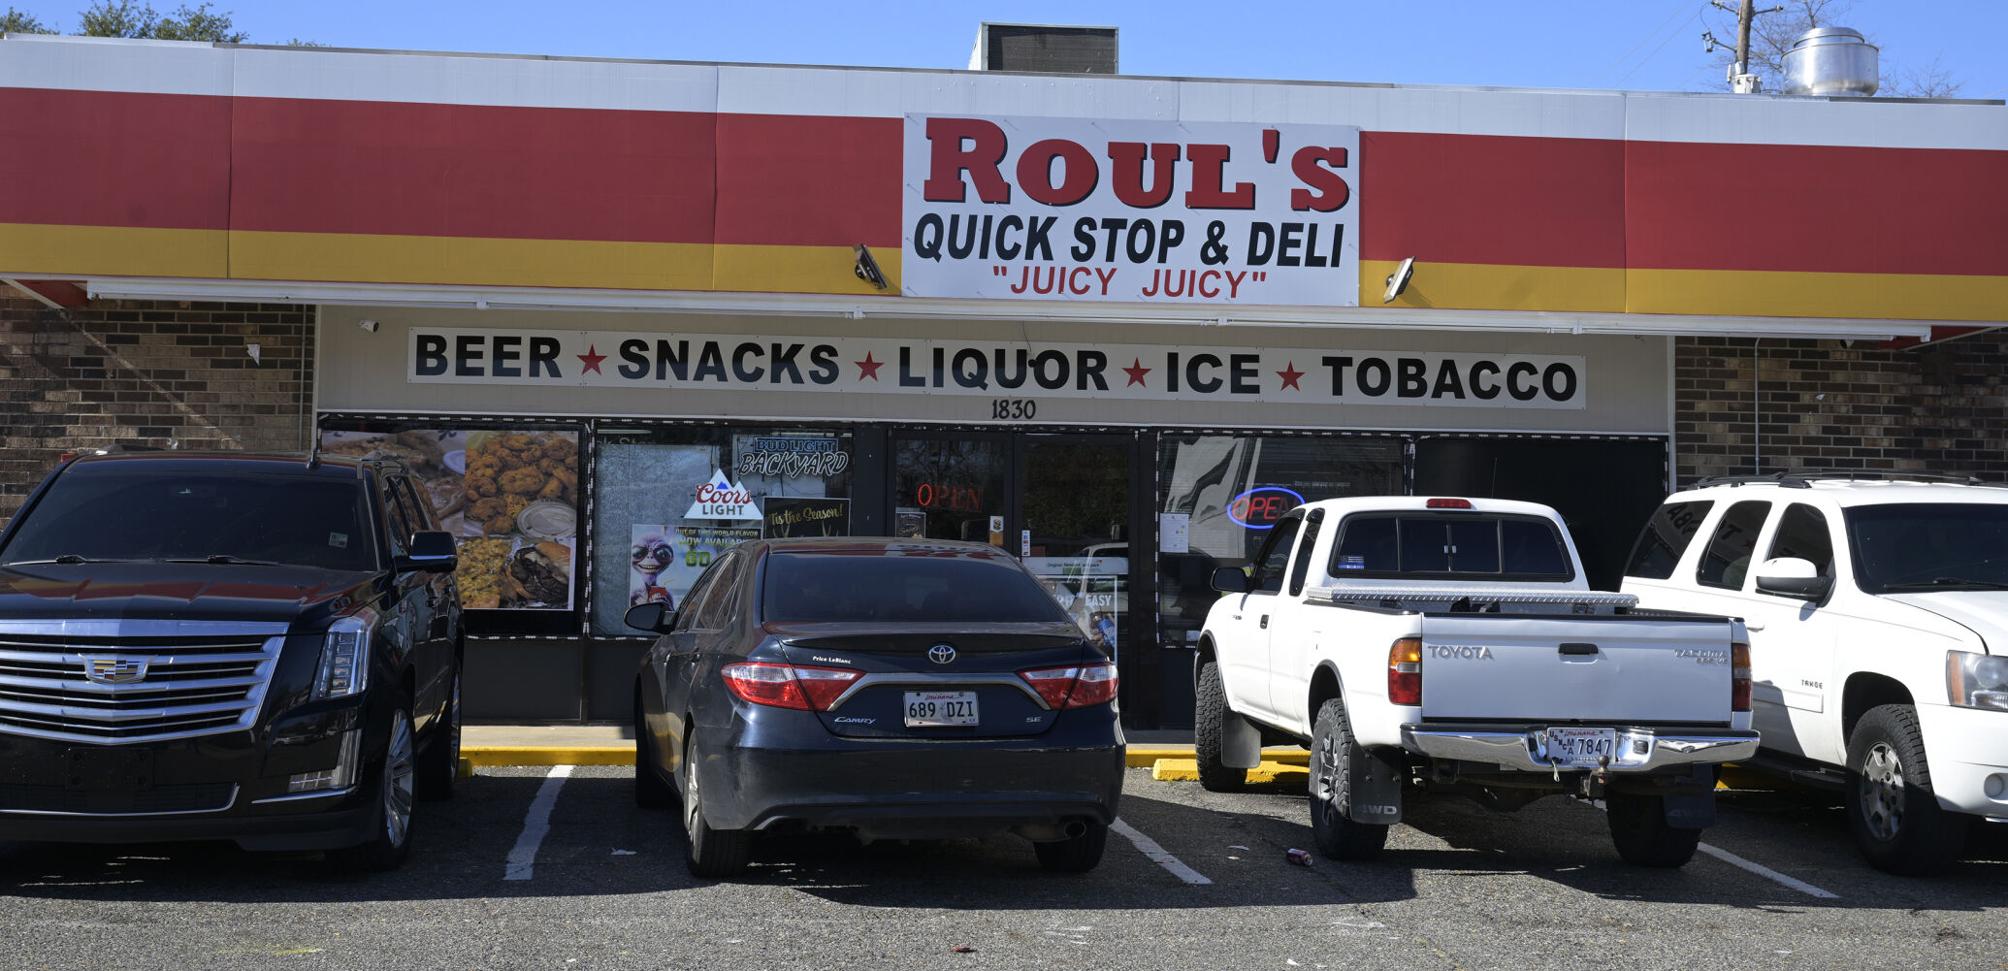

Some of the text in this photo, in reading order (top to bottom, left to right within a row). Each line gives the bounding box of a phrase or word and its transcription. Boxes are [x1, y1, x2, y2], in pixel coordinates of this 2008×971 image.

[923, 117, 1350, 212] ROUL'S
[914, 213, 1344, 268] QUICK STOP & DELI
[993, 266, 1267, 299] "JUICY JUICY"
[415, 334, 1577, 403] BEER SNACKS LIQUOR ICE TOBACCO
[991, 399, 1036, 420] 1830
[756, 439, 836, 451] BUD LIGHT
[740, 451, 848, 478] BACKYARD
[696, 483, 752, 505] Coors
[917, 483, 984, 512] OPEN
[702, 505, 745, 515] LIGHT
[712, 529, 734, 537] WORLD
[1085, 594, 1112, 607] EASY
[1428, 646, 1494, 660] TOYOTA
[1801, 679, 1823, 690] TAHOE
[909, 700, 974, 718] 689 DZI
[1577, 738, 1612, 756] 7847
